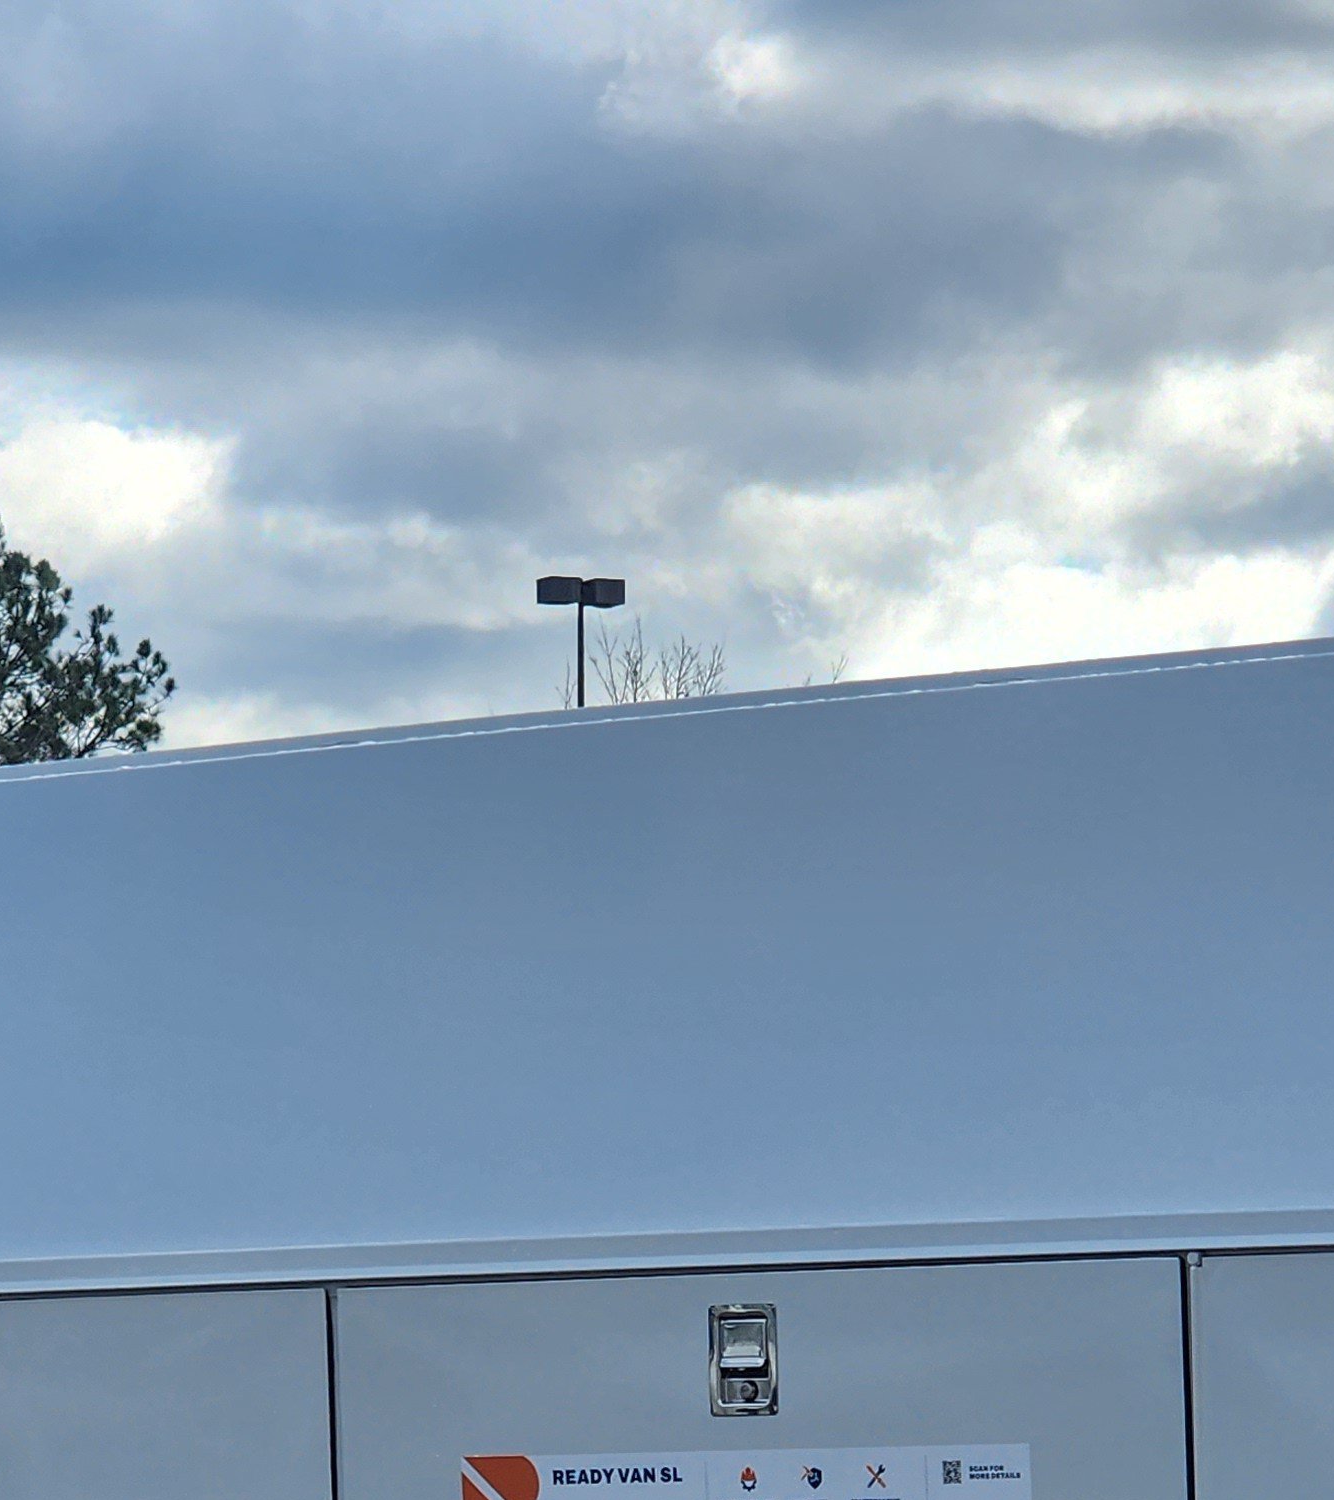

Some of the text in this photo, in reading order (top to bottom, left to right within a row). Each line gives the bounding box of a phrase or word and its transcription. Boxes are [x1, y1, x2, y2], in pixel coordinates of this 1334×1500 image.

[552, 1466, 683, 1485] READY VAN SL
